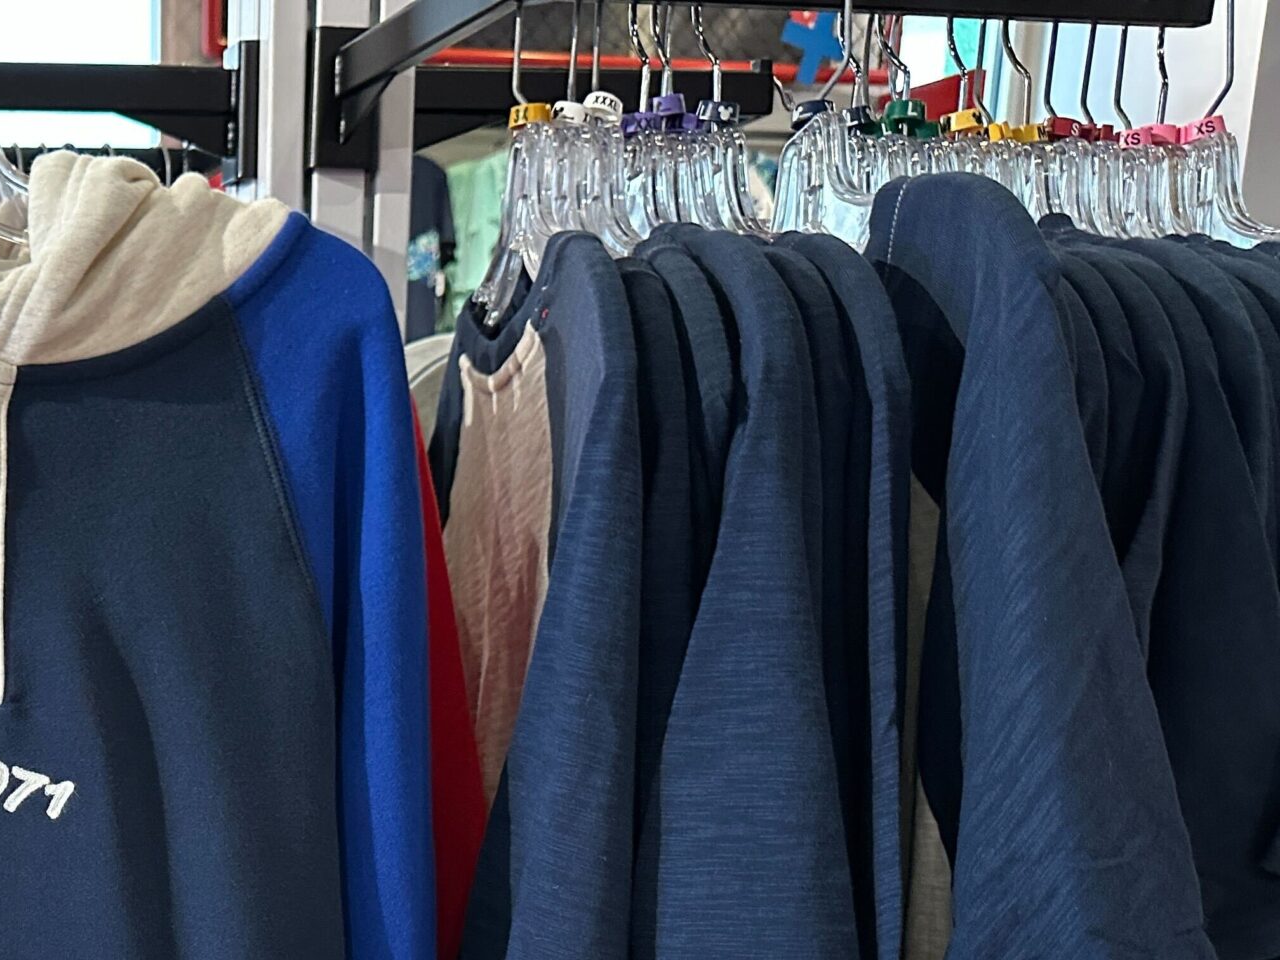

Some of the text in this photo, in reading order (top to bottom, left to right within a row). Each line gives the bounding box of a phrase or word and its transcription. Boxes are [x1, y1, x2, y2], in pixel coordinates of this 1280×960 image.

[593, 95, 617, 111] XXXL
[907, 101, 918, 115] L
[881, 122, 892, 136] L
[1071, 123, 1080, 137] S
[1194, 120, 1216, 135] XS
[1121, 132, 1141, 146] XS
